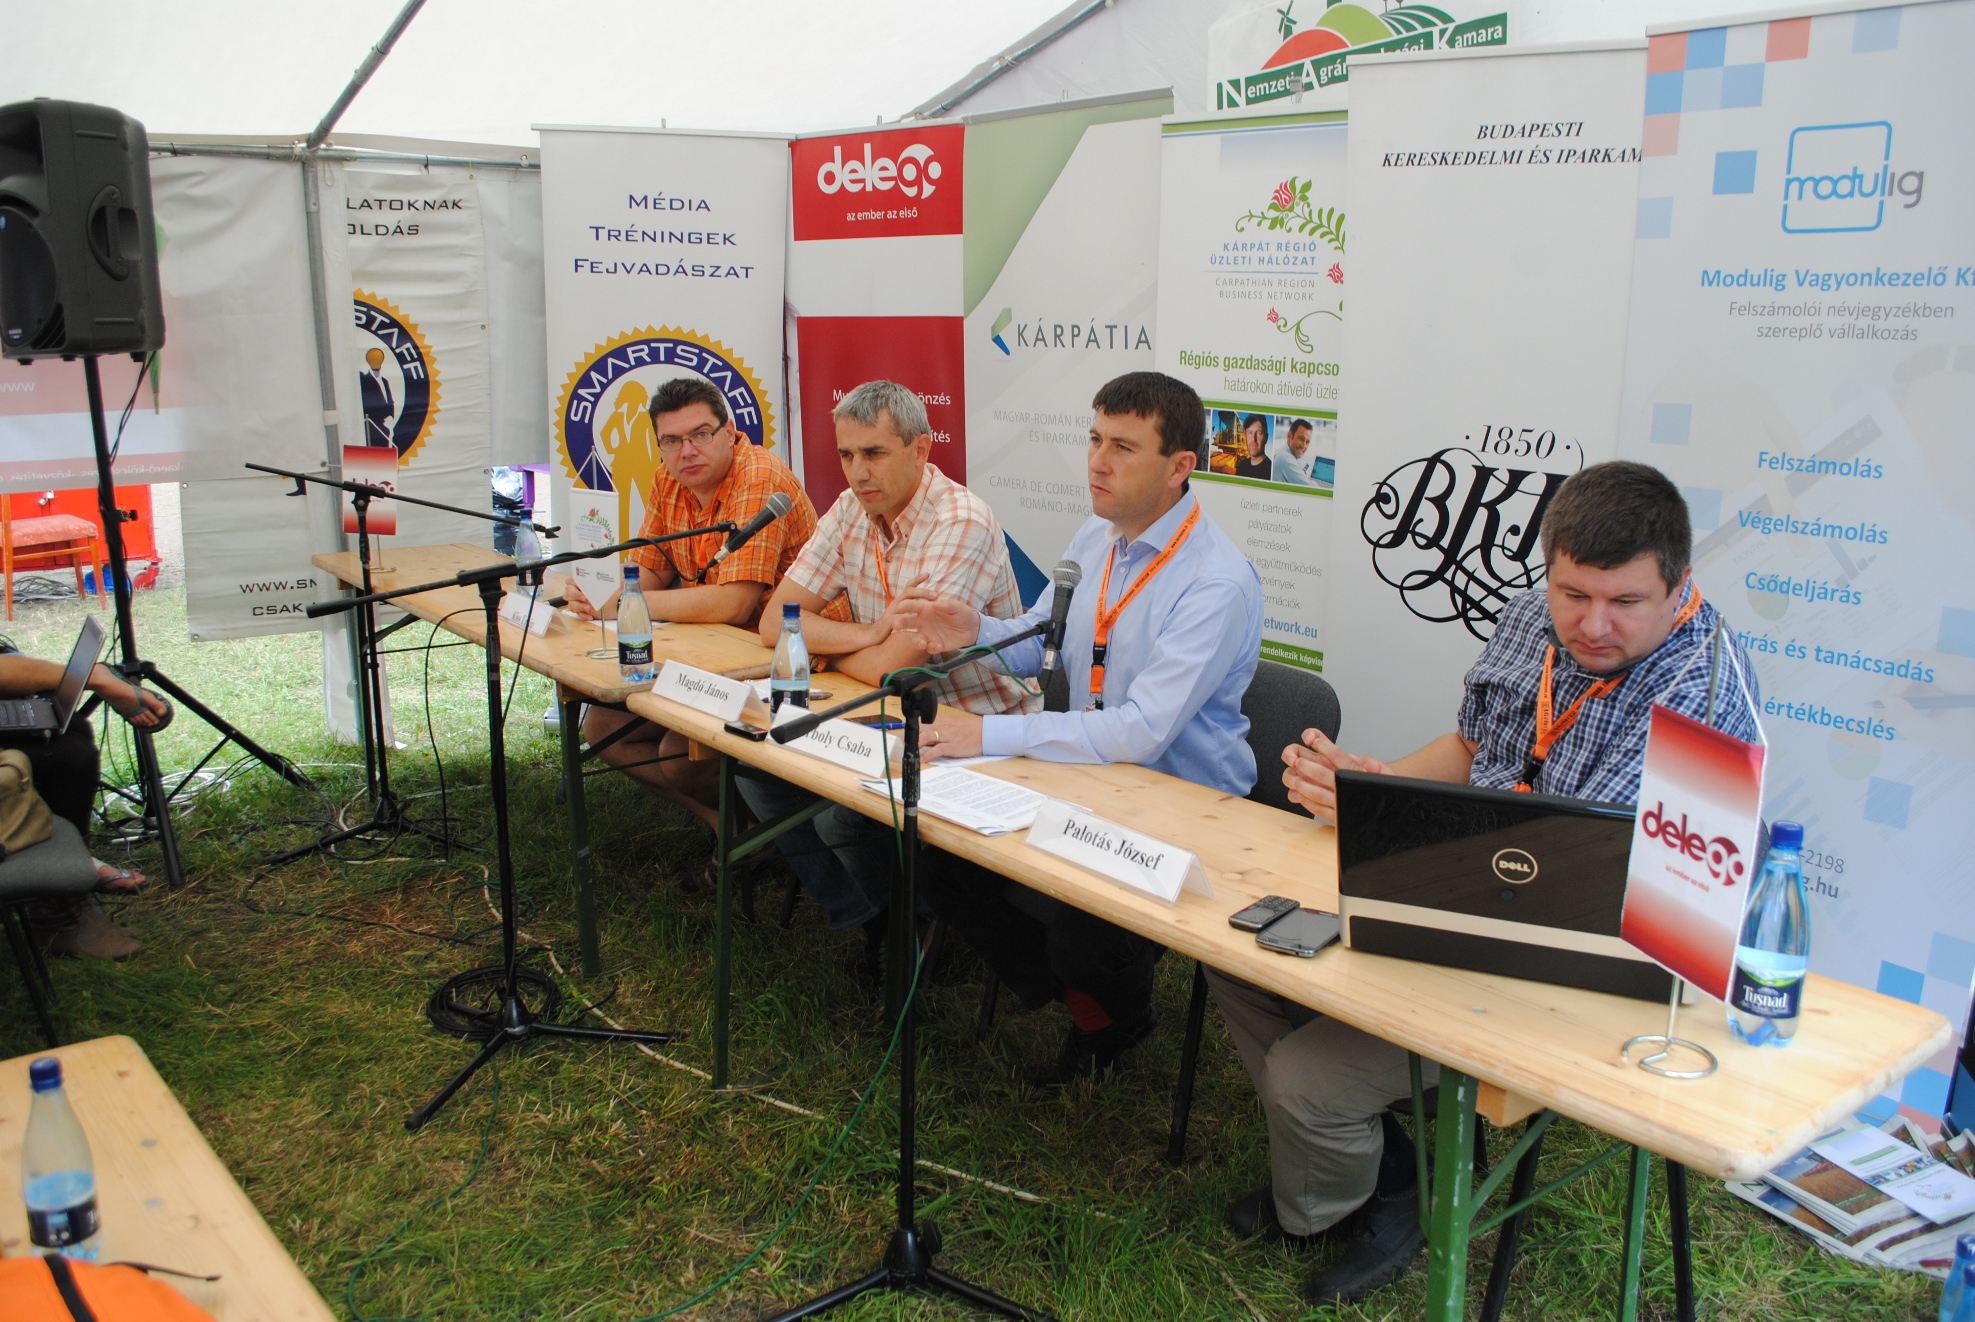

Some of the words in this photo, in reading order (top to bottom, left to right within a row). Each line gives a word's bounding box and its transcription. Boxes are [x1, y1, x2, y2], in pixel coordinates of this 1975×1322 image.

[1433, 23, 1503, 50] Kamara
[1476, 121, 1584, 140] BUDAPESTI
[1381, 150, 1525, 168] KERESKEDELMI
[1528, 144, 1551, 165] ÉS
[817, 142, 942, 200] delego
[1784, 164, 1925, 210] modulig
[628, 191, 711, 212] MÉDIA
[846, 212, 856, 221] az
[857, 208, 885, 221] ember
[887, 209, 898, 219] az
[899, 206, 918, 219] első
[589, 223, 737, 246] TRÉNINGEK
[1223, 241, 1271, 253] KÁRPÁT
[1276, 240, 1317, 253] RÉGIÓ
[574, 258, 755, 279] FEJVADÁSZAT
[1210, 254, 1252, 266] ÜZLETI
[1258, 254, 1317, 267] HÁLÓZAT
[1215, 278, 1273, 288] CARPATHIAN
[1277, 279, 1315, 289] REGION
[1700, 268, 1787, 292] Modulig
[1794, 266, 1948, 292] Vagyonkezelő
[1219, 290, 1263, 300] BUSINESS
[1267, 291, 1314, 302] NETWORK
[1729, 301, 1822, 318] Felszámolói
[1826, 302, 1955, 322] névjegyzékben
[1016, 317, 1152, 351] KÁRPÁTIA
[1756, 322, 1823, 342] szereplő
[1828, 323, 1919, 342] vállalkozás
[1179, 350, 1219, 371] Régiós
[1223, 354, 1287, 376] gazdasági
[1290, 357, 1340, 378] kapcso
[570, 342, 758, 426] SMARTSTAFF
[1223, 376, 1274, 394] határokon
[1276, 379, 1313, 398] átívelő
[1316, 383, 1339, 400] üzle
[993, 410, 1072, 428] MAGYAR-ROMÁN
[1029, 430, 1040, 443] ÉS
[1476, 424, 1557, 460] 1850
[1757, 450, 1884, 480] Felszámolás
[989, 475, 1028, 492] CAMERA
[1030, 481, 1043, 493] DE
[1262, 503, 1303, 518] partnerek
[1247, 519, 1292, 535] pályázatok
[1737, 509, 1889, 545] Végelszámolás
[1246, 536, 1291, 553] elemzések
[1744, 571, 1863, 606] Csődeljárás
[252, 602, 304, 616] CSAK
[1784, 637, 1807, 660] és
[1814, 644, 1935, 684] tanácsadás
[675, 672, 705, 693] Magdó
[704, 682, 730, 702] János
[1764, 696, 1896, 742] értékbecslés
[837, 734, 872, 758] Csaba
[1062, 818, 1113, 852] Palotás
[1113, 838, 1165, 871] József
[1641, 800, 1745, 887] delego
[1498, 859, 1532, 873] DELL
